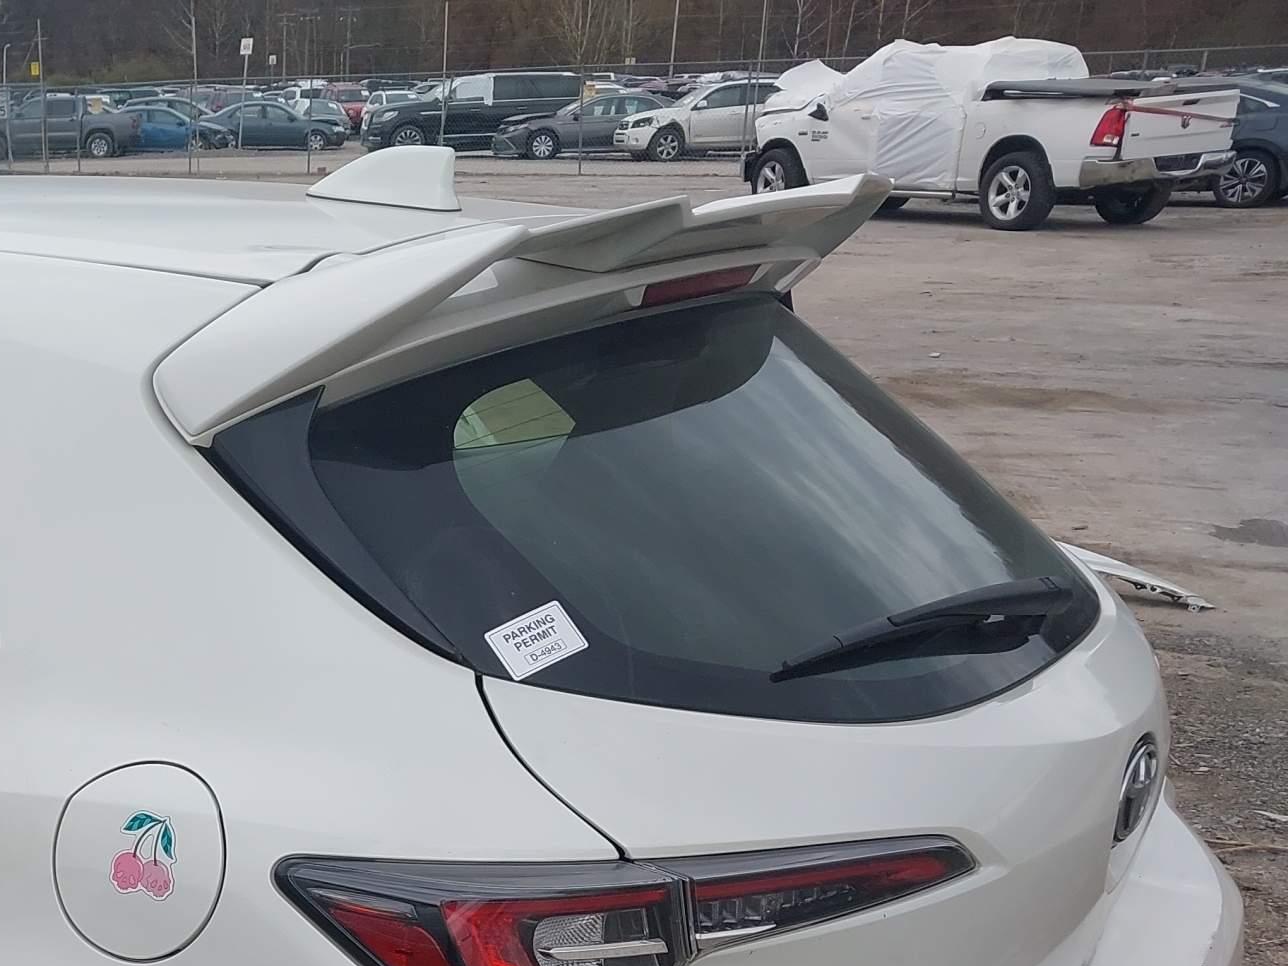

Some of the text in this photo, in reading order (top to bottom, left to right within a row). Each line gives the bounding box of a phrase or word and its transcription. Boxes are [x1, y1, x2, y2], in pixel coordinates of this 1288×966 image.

[503, 614, 556, 643] PARKING
[514, 625, 558, 652] PERMIT
[529, 642, 563, 662] D-4943
